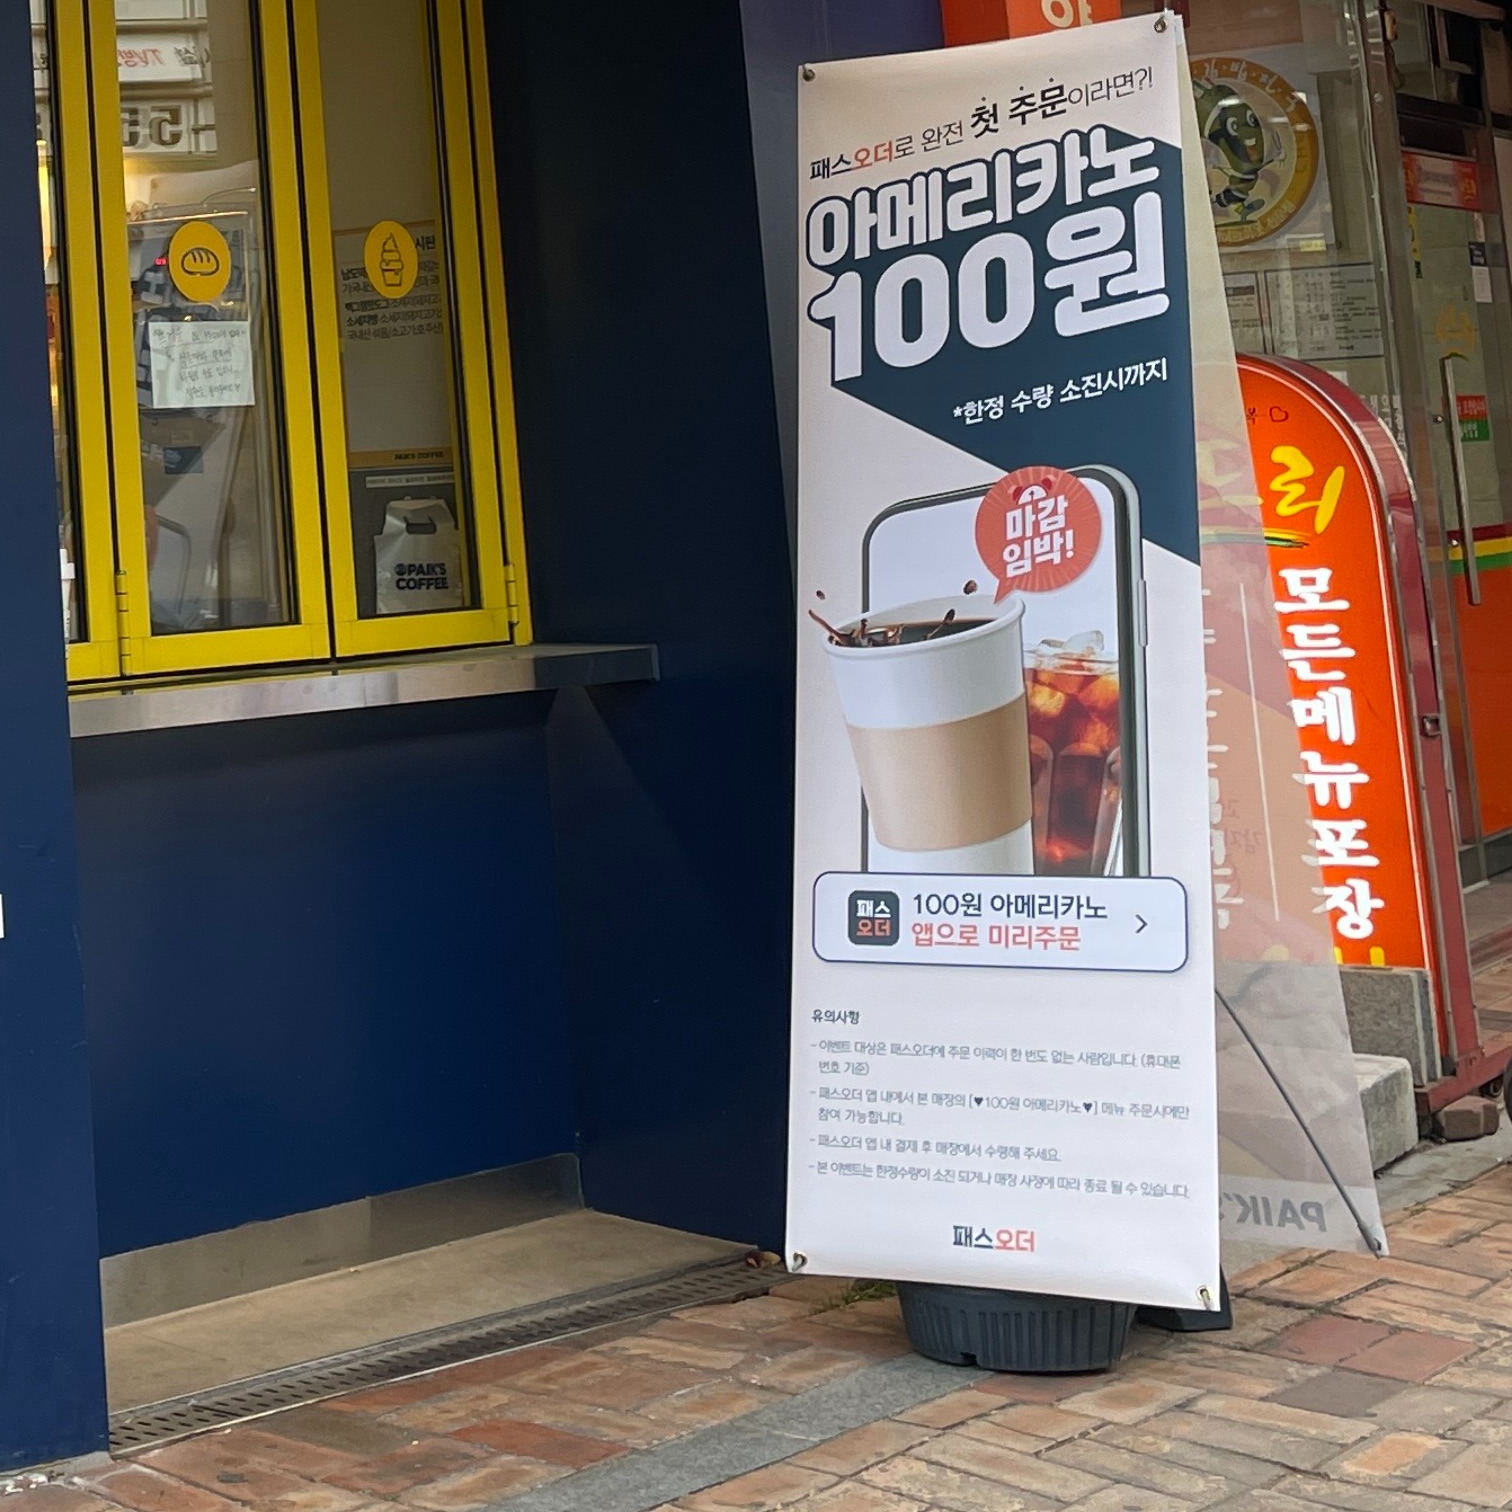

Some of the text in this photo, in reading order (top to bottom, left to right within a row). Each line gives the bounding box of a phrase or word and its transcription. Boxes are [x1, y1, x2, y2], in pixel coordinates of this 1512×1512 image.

[809, 136, 915, 181] 패스오더로
[921, 120, 964, 149] 완전
[970, 100, 1000, 139] 첫
[807, 125, 1160, 266] 아메리카노
[808, 191, 1170, 382] 100원
[1010, 383, 1054, 413] 수량
[1059, 357, 1169, 404] 소진시까지
[1005, 496, 1069, 541] 마감
[1002, 530, 1075, 579] 임박!
[396, 577, 449, 590] COFFEE
[407, 563, 447, 576] PAIK'S
[856, 899, 891, 918] 패스
[913, 892, 1108, 920] 100원 아메리카노
[856, 918, 892, 937] 오더
[912, 922, 1081, 951] 앱으로 미리주문
[812, 1009, 860, 1025] 유의사항
[819, 1040, 852, 1053] 이벤트
[854, 1041, 887, 1056] 대상은
[890, 1042, 945, 1058] 패스오더에
[948, 1045, 970, 1060] 주문
[1010, 1048, 1022, 1062] 한
[1025, 1049, 1048, 1063] 번도
[1051, 1050, 1074, 1065] 없는
[819, 1061, 870, 1076] 번호 기준)
[818, 1107, 841, 1122] 참여
[819, 1086, 862, 1101] 패스오더
[865, 1088, 877, 1103] 앱
[880, 1090, 914, 1105] 내에서
[917, 1092, 928, 1105] 본
[932, 1092, 966, 1108] 매장의
[1102, 1102, 1125, 1117] 메뉴
[818, 1134, 862, 1149] 패스오더
[865, 1137, 877, 1151] 앱
[880, 1138, 891, 1152] 내
[895, 1139, 918, 1154] 결제
[921, 1140, 932, 1154] 후
[935, 1141, 981, 1157] 매장에서
[985, 1144, 1021, 1160] 수령해
[817, 1161, 828, 1175] 본
[830, 1162, 873, 1178] 이벤트는
[933, 1168, 955, 1183] 소진
[958, 1169, 991, 1185] 되거나
[994, 1172, 1017, 1187] 매장
[1019, 1174, 1055, 1190] 사정에
[1057, 1176, 1080, 1192] 따라
[1125, 1180, 1138, 1196] 수
[953, 1224, 1036, 1253] 패스오더
